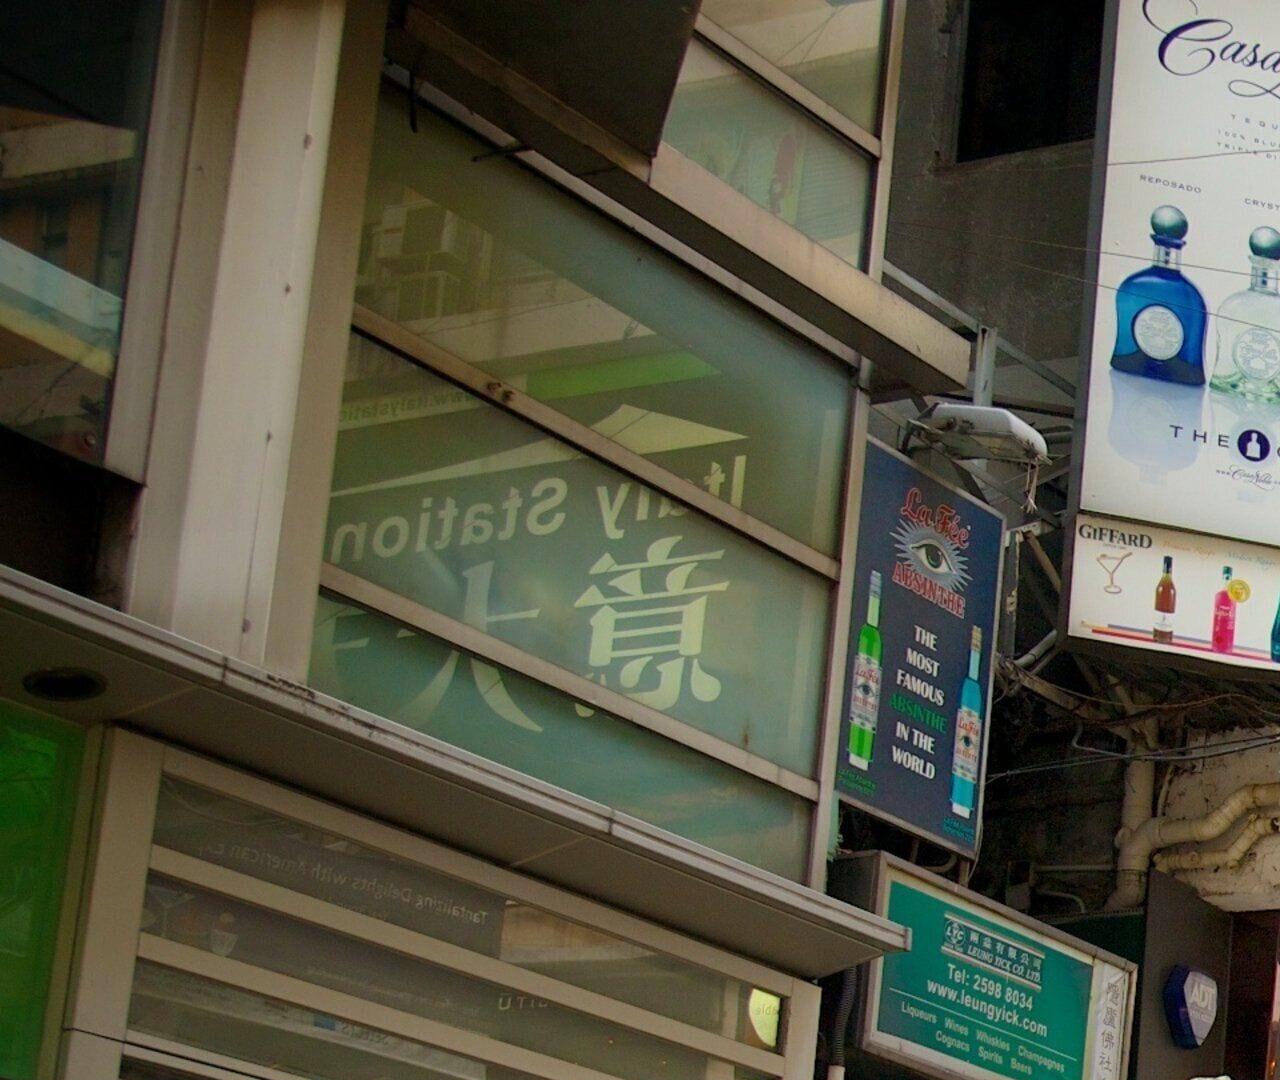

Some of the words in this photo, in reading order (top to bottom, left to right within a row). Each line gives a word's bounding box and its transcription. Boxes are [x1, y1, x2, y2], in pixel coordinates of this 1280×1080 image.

[1139, 174, 1202, 194] REPOSADO
[1169, 424, 1230, 449] THE
[901, 488, 932, 527] La
[1077, 523, 1153, 550] GIFFARD
[892, 561, 966, 619] ABSINTHE
[914, 625, 937, 651] THE
[906, 648, 941, 678] MOST
[897, 669, 945, 706] FAMOUS
[889, 692, 947, 735] ABSINTHE
[896, 721, 909, 741] IN
[912, 729, 936, 755] THE
[891, 746, 936, 780] WORLD
[967, 946, 993, 964] LEUNG
[947, 963, 970, 986] Tel:
[973, 974, 1002, 999] 2598
[1004, 986, 1033, 1012] 8034
[926, 979, 1048, 1038] www.leungyick.com
[901, 1000, 937, 1024] Liqueurs
[944, 1017, 969, 1036] Wines
[976, 1028, 1011, 1052] Whiskies
[1017, 1044, 1066, 1073] Champagnes
[935, 1031, 970, 1053] Cognacs
[978, 1046, 1004, 1066] Spirits
[1010, 1058, 1033, 1076] Beers
